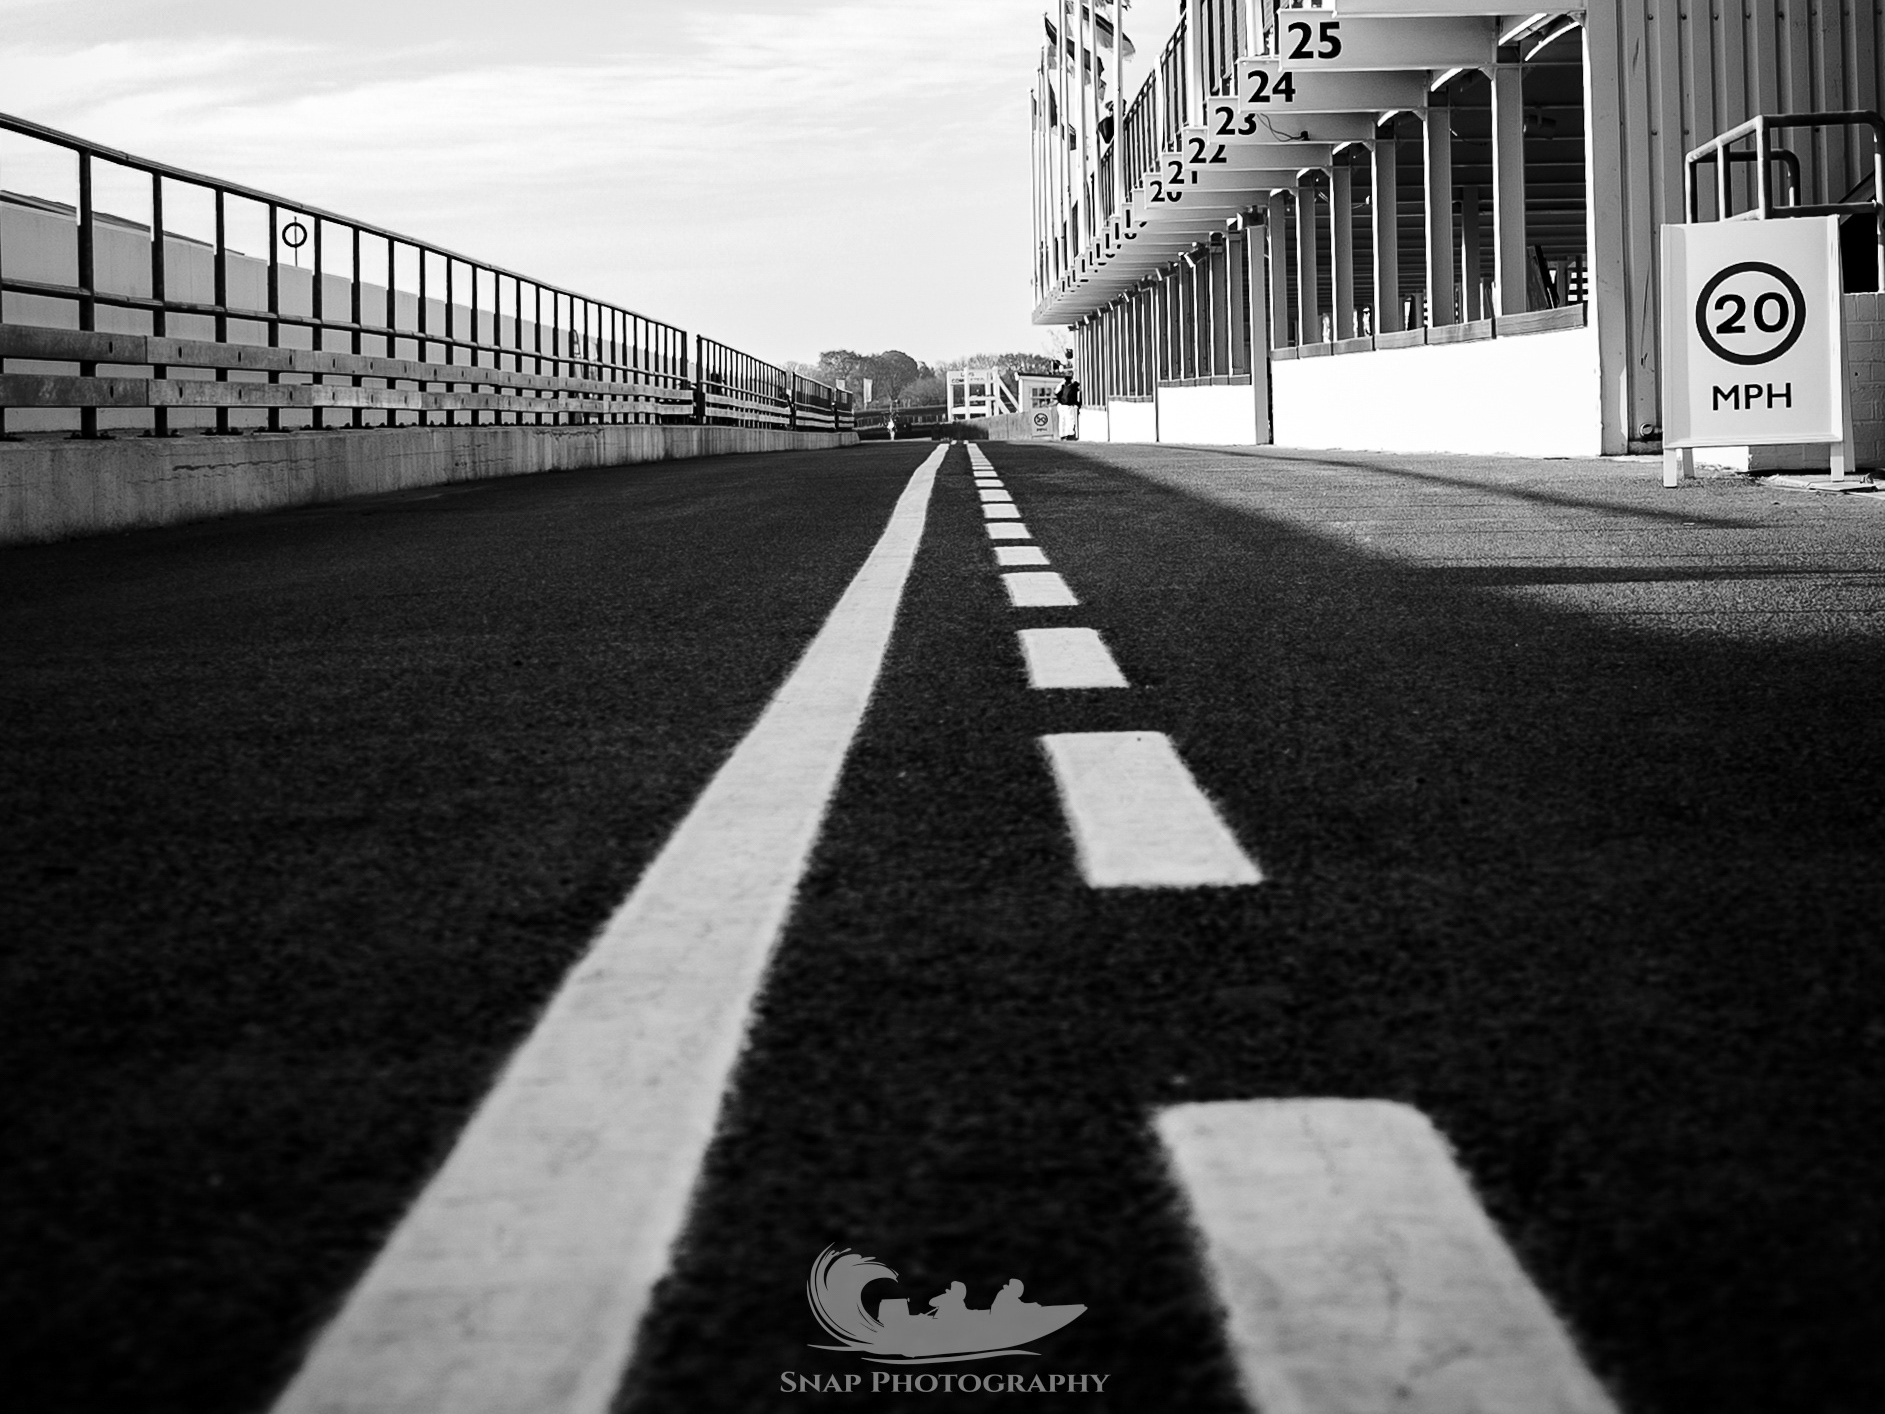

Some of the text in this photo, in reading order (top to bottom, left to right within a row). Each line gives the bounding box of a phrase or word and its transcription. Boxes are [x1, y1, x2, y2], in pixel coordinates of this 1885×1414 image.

[1288, 21, 1342, 60] 25
[1247, 70, 1296, 103] 24
[1215, 106, 1257, 136] 23
[1188, 137, 1227, 164] 22
[1714, 291, 1789, 334] 20
[1712, 382, 1792, 411] MPH
